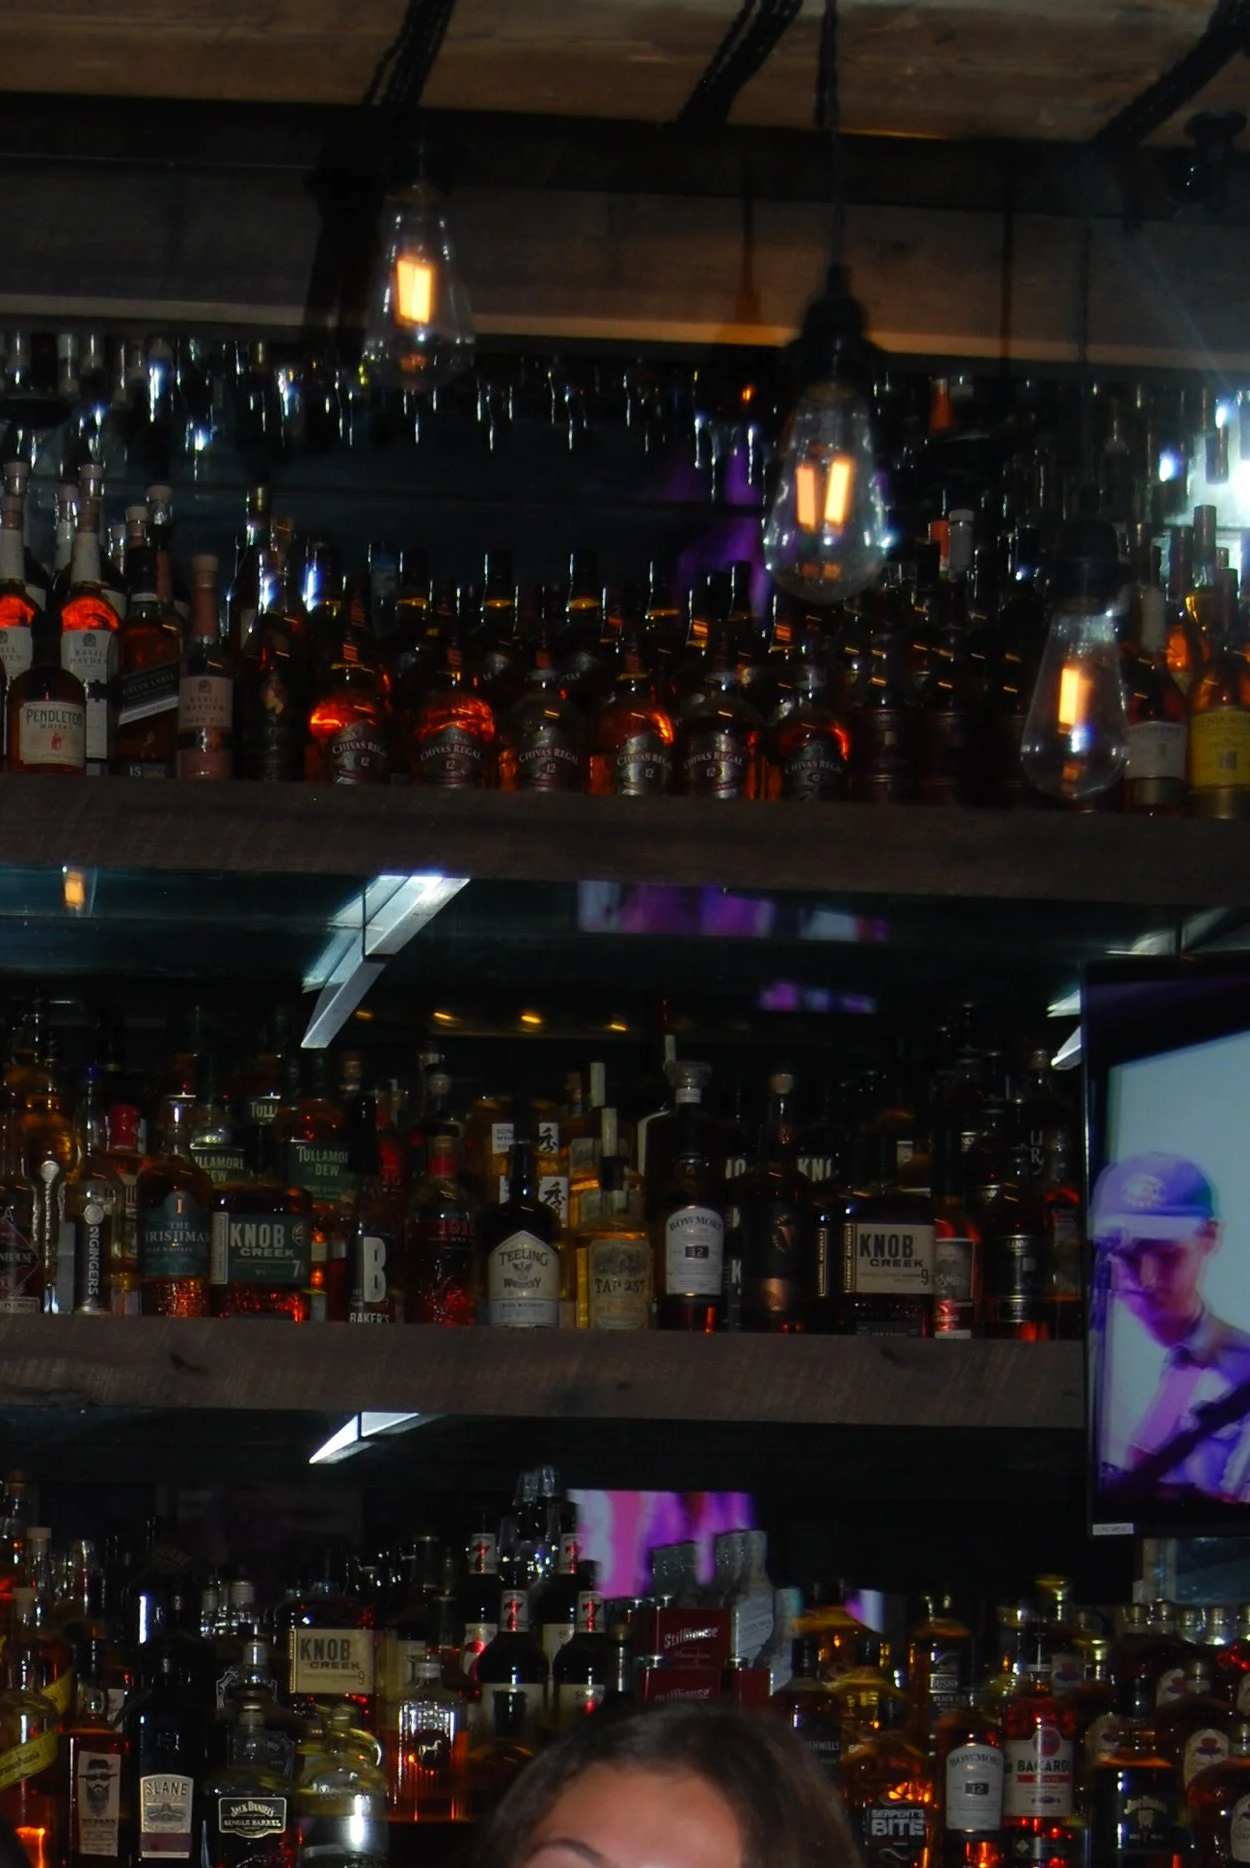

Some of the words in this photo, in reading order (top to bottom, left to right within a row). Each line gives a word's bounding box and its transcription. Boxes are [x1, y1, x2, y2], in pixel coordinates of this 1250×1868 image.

[331, 740, 367, 754] CHIVAS
[419, 744, 452, 761] CHIVAS
[452, 743, 483, 760] REGAL
[518, 747, 552, 763] CHIVAS
[553, 747, 579, 765] REGAL
[616, 751, 650, 767] CHIVAS
[683, 752, 716, 769] CHIVAS
[717, 750, 744, 767] REGAL
[209, 1170, 228, 1183] EW
[314, 1164, 339, 1177] DEW
[170, 1221, 190, 1230] THE
[229, 1223, 286, 1249] KNOB
[239, 1248, 295, 1258] CREEK
[859, 1233, 913, 1258] KNOB
[499, 1250, 548, 1267] TEELING
[869, 1259, 923, 1268] CREEK
[363, 1236, 388, 1304] B
[920, 1269, 929, 1286] 9
[595, 1279, 621, 1294] TAP
[300, 1639, 351, 1661] KNOB
[309, 1661, 360, 1670] CREEK
[357, 1671, 366, 1686] 9
[146, 1782, 189, 1797] SLANE
[230, 1803, 248, 1817] JACK
[871, 1818, 926, 1837] BITE
